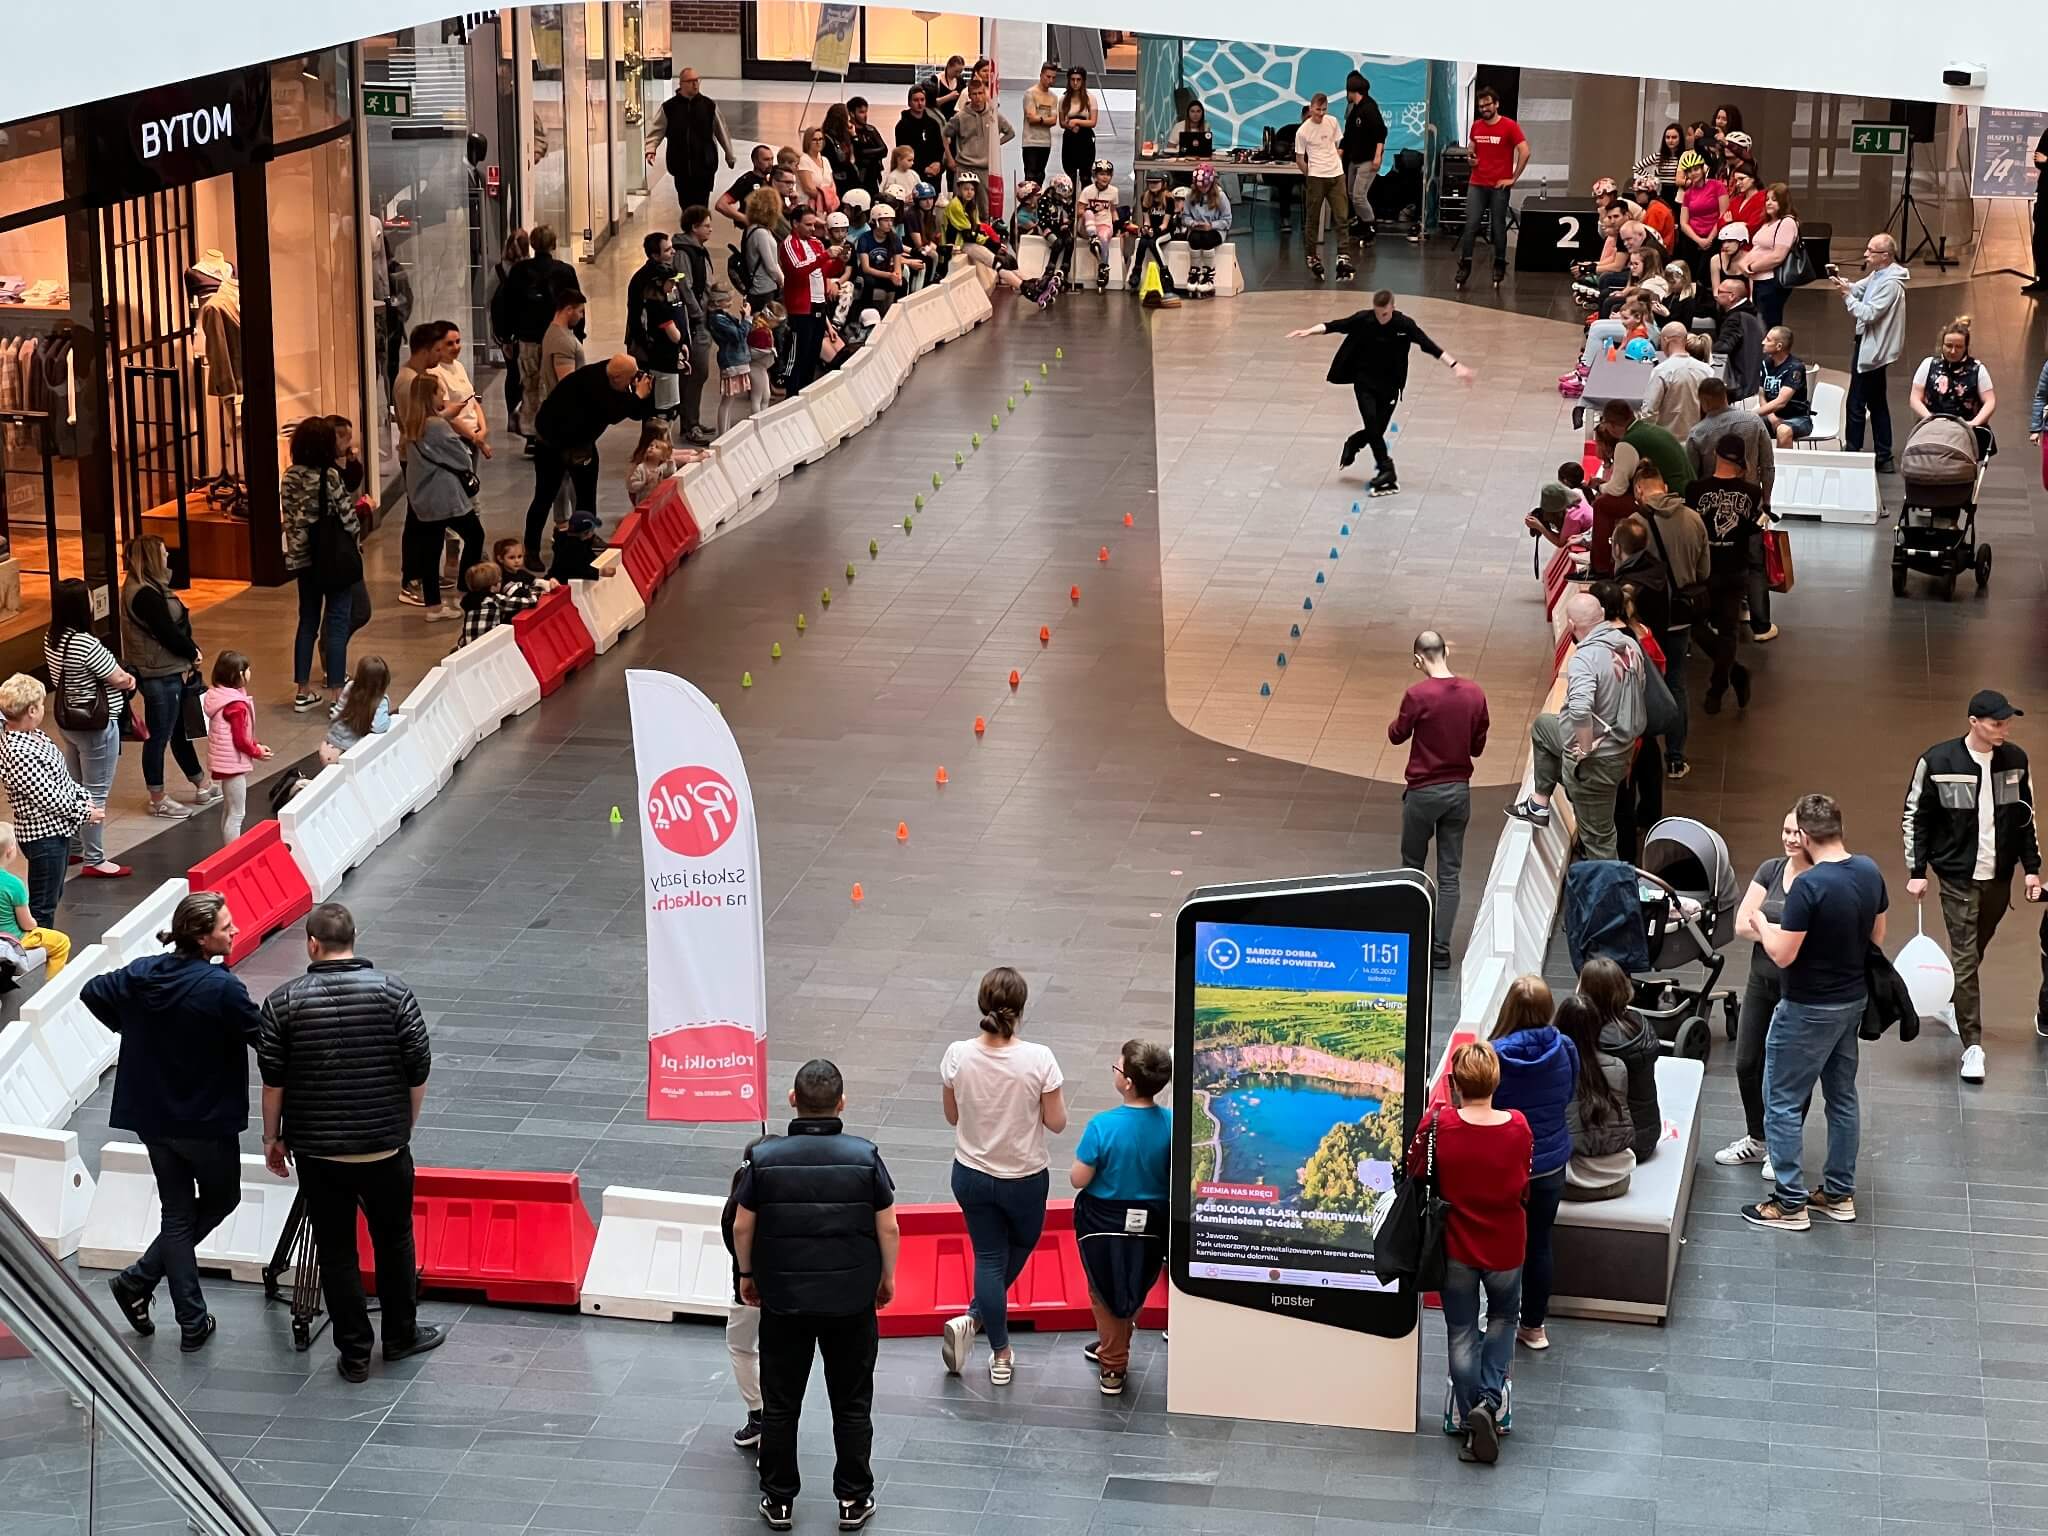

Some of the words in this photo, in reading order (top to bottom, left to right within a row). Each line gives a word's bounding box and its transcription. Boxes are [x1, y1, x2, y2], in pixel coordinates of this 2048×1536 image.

[142, 103, 232, 158] BYTOM
[1556, 216, 1580, 248] 2
[1246, 947, 1284, 957] BARDZO
[1285, 949, 1317, 958] DOBRA
[1361, 943, 1399, 964] 11:51
[1282, 959, 1336, 969] POWIETRZA
[1362, 967, 1397, 975] 14.05.2022
[1201, 1186, 1230, 1195] ZIEMIA
[1230, 1188, 1248, 1196] NAS
[1205, 1232, 1239, 1241] Jaworzno
[1196, 1240, 1212, 1248] Park
[1213, 1242, 1250, 1251] utworzony
[1271, 1292, 1315, 1307] iposter
